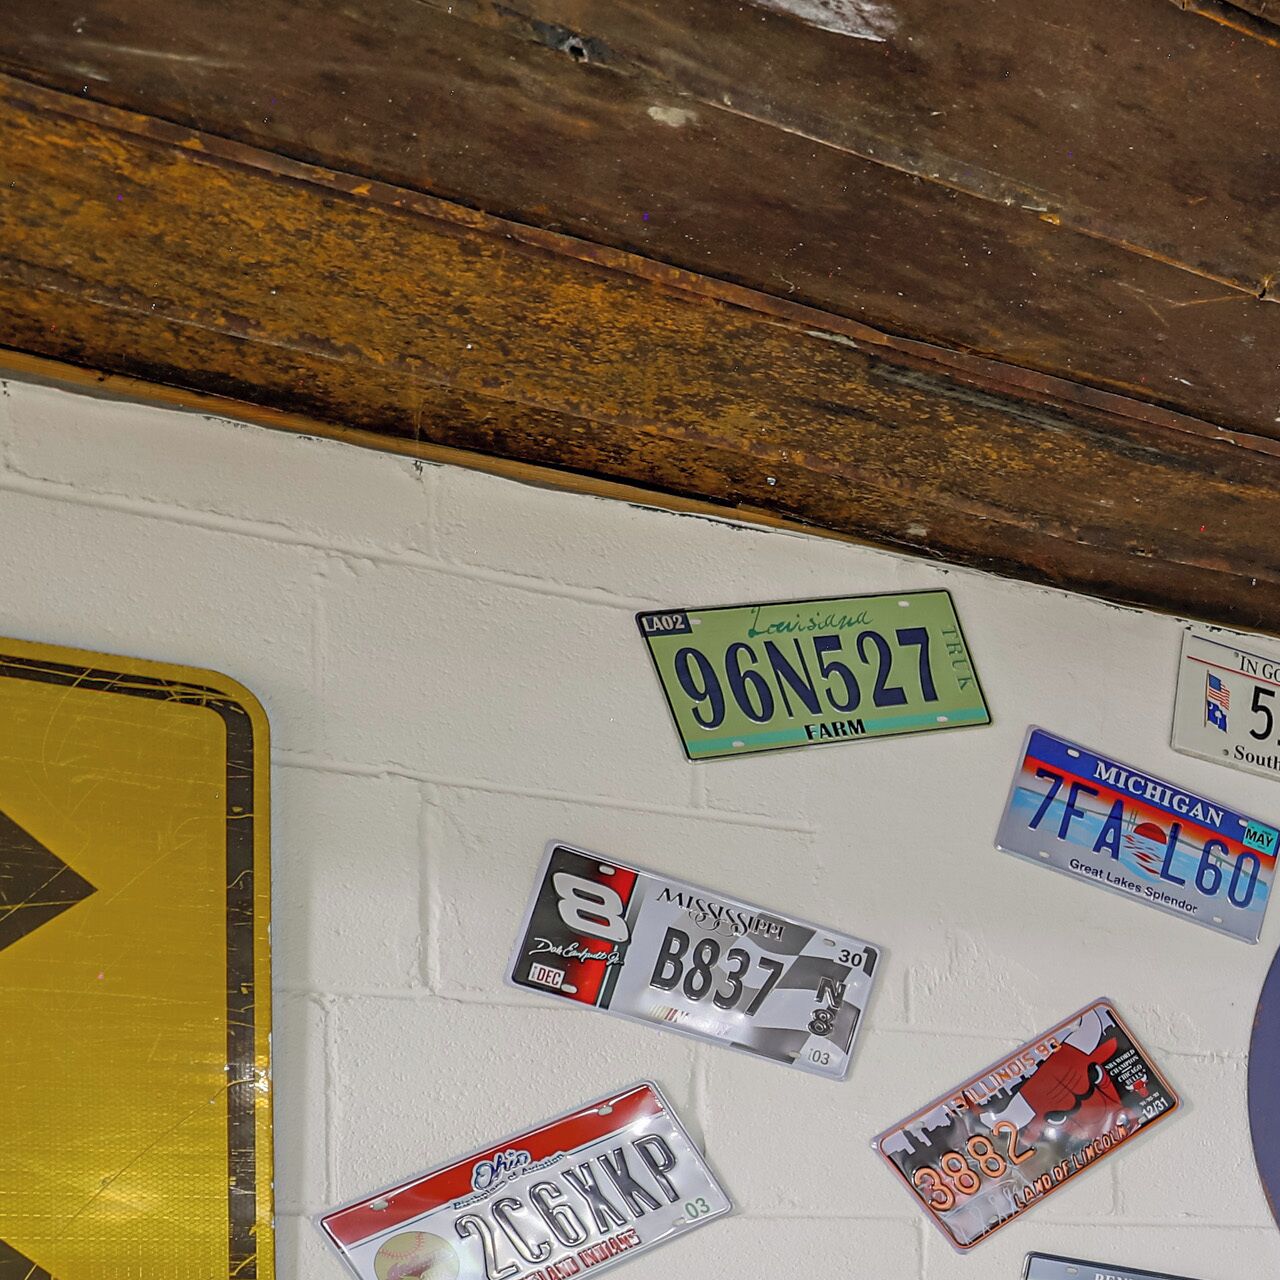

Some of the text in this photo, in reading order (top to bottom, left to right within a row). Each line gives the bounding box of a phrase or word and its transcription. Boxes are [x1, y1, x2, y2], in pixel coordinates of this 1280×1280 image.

[642, 615, 685, 634] LA02
[746, 605, 874, 639] Louisiana
[674, 626, 942, 731] 96N527
[1239, 654, 1259, 675] IN
[804, 719, 866, 742] FARM
[1093, 759, 1225, 829] MICHIGAN
[1245, 828, 1274, 848] MAY
[1069, 857, 1198, 916] Great Lakes Splendor
[553, 871, 631, 943] 8
[536, 967, 561, 986] DEC
[649, 926, 785, 1017] B837
[838, 949, 863, 967] 30
[964, 1052, 1037, 1105] ILLINOIS
[1141, 1096, 1169, 1120] 12/31
[473, 1149, 531, 1191] Ohio
[521, 1152, 565, 1176] Aviation
[913, 1120, 1037, 1215] 3882
[1013, 1123, 1131, 1211] LAND OF LINCOLN
[684, 1197, 711, 1220] 03
[578, 1228, 643, 1269] INDIANS
